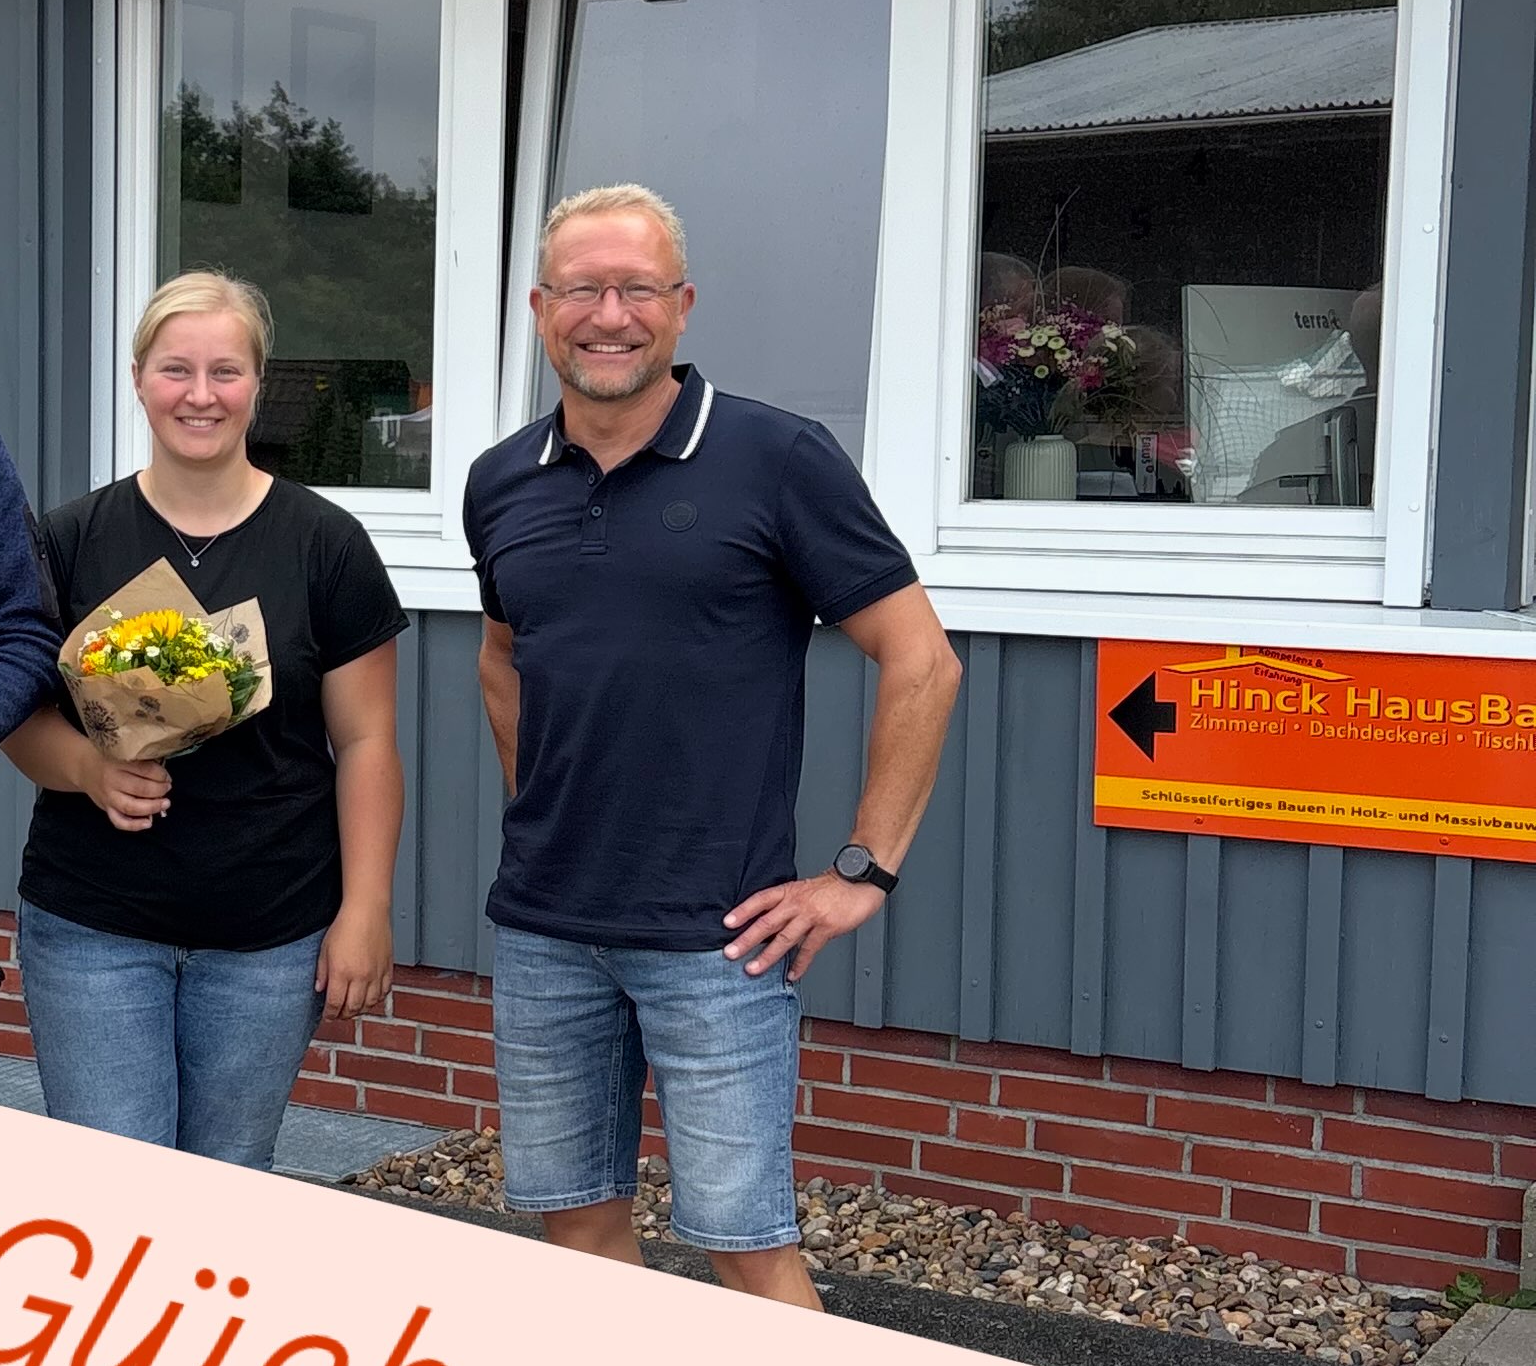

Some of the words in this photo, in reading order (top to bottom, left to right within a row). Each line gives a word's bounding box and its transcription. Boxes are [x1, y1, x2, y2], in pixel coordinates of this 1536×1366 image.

[1294, 311, 1330, 329] terra
[1254, 666, 1303, 686] Erfahrung
[1190, 677, 1331, 717] Hinck
[1346, 685, 1536, 729] HausBa
[1190, 712, 1287, 736] Zimmerei
[1310, 720, 1449, 746] Dachdeckerei
[1141, 789, 1273, 811] Schlüsselfertiges
[1277, 800, 1326, 815] Bauen
[1331, 804, 1346, 816] in
[1350, 806, 1394, 820] Holz-
[1398, 812, 1429, 823] und
[1435, 813, 1536, 831] Massivbauw
